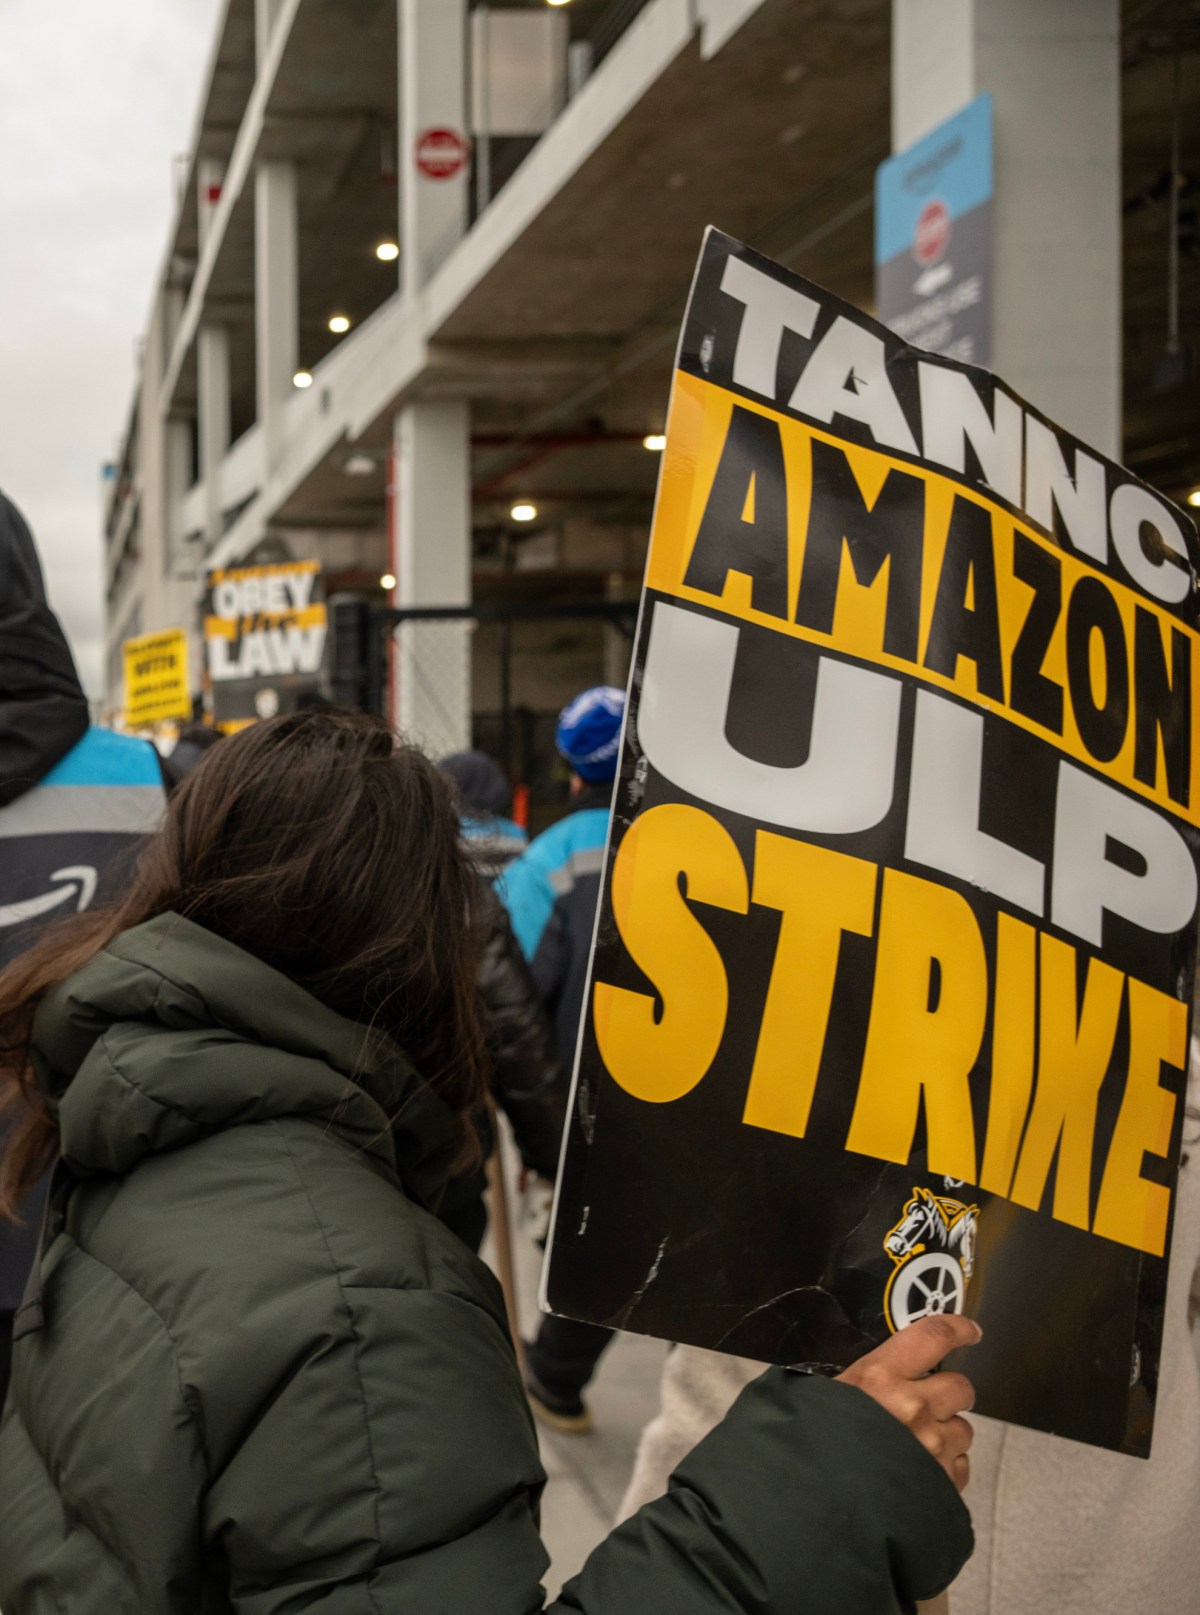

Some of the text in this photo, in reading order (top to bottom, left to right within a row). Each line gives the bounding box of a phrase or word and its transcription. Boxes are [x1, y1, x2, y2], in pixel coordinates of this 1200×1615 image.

[212, 572, 315, 619] OBEY
[720, 253, 1191, 604] TANNC
[207, 626, 327, 681] LAW
[637, 601, 1198, 948] ULP
[682, 403, 1192, 811] AMAZON
[593, 803, 1188, 1258] STRIKE
